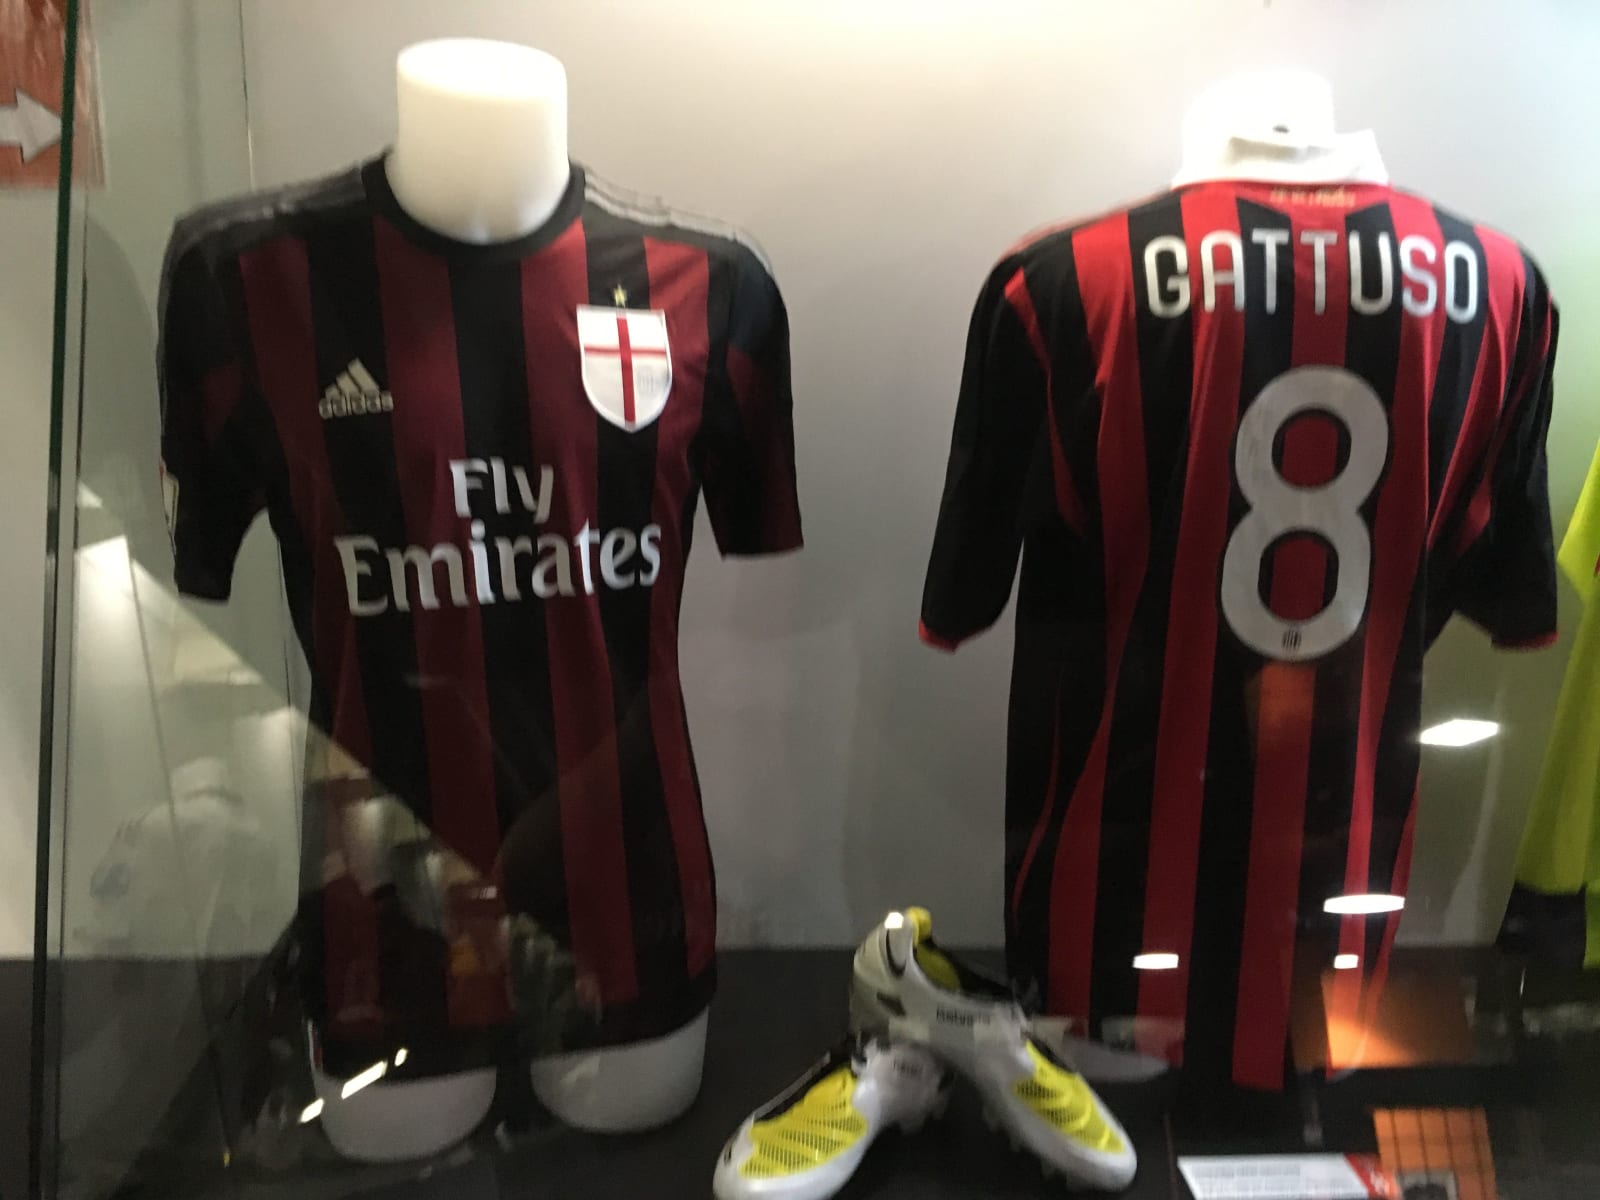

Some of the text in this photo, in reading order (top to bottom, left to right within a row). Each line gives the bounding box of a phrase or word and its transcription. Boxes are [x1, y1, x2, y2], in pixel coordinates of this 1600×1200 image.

[1144, 229, 1478, 323] GATTUSO
[318, 391, 394, 420] adidas
[449, 457, 554, 523] Fly
[1220, 365, 1388, 661] 8
[334, 518, 662, 616] Emirates
